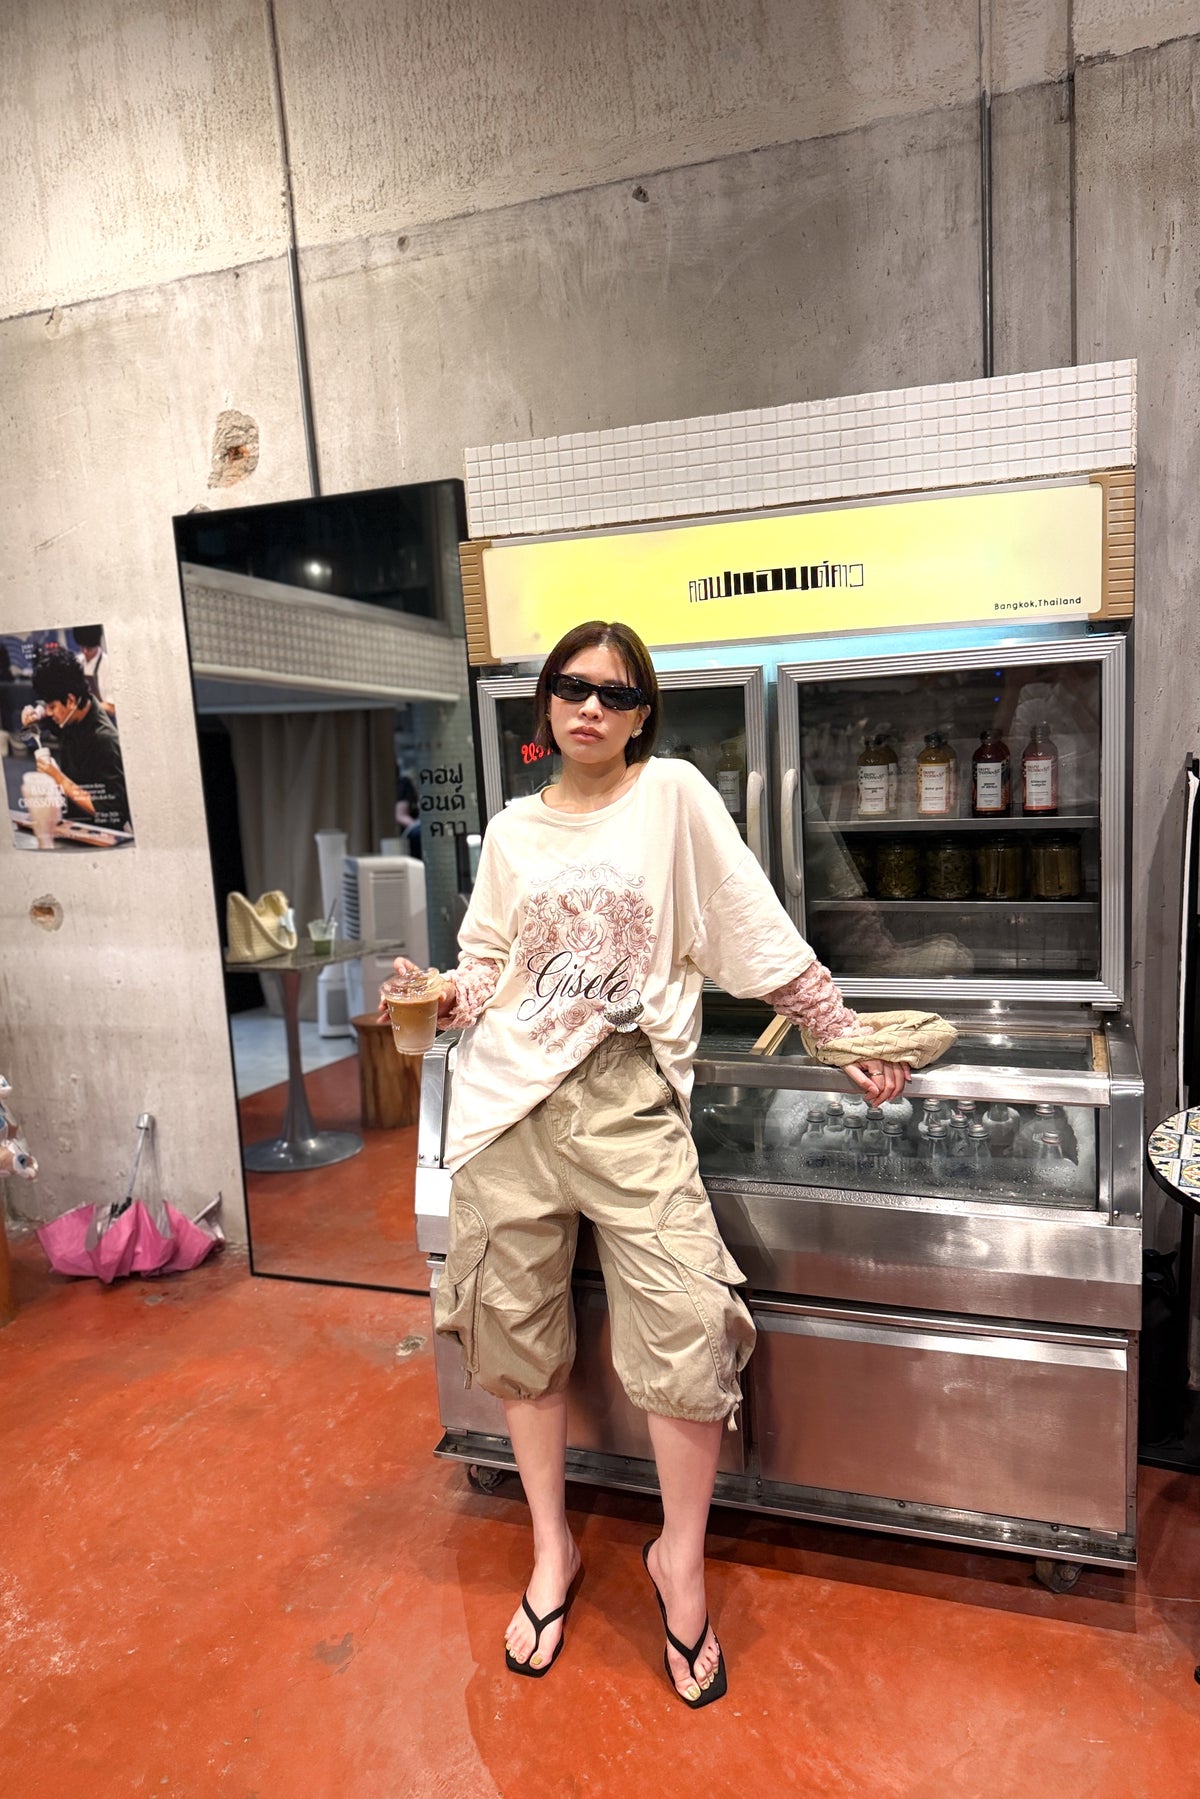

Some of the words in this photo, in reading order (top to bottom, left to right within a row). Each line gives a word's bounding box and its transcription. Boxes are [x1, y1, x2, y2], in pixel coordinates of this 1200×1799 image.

[993, 596, 1082, 611] Bangkok,Thailand
[419, 764, 464, 785] คอฟ
[517, 950, 641, 1021] Gisele
